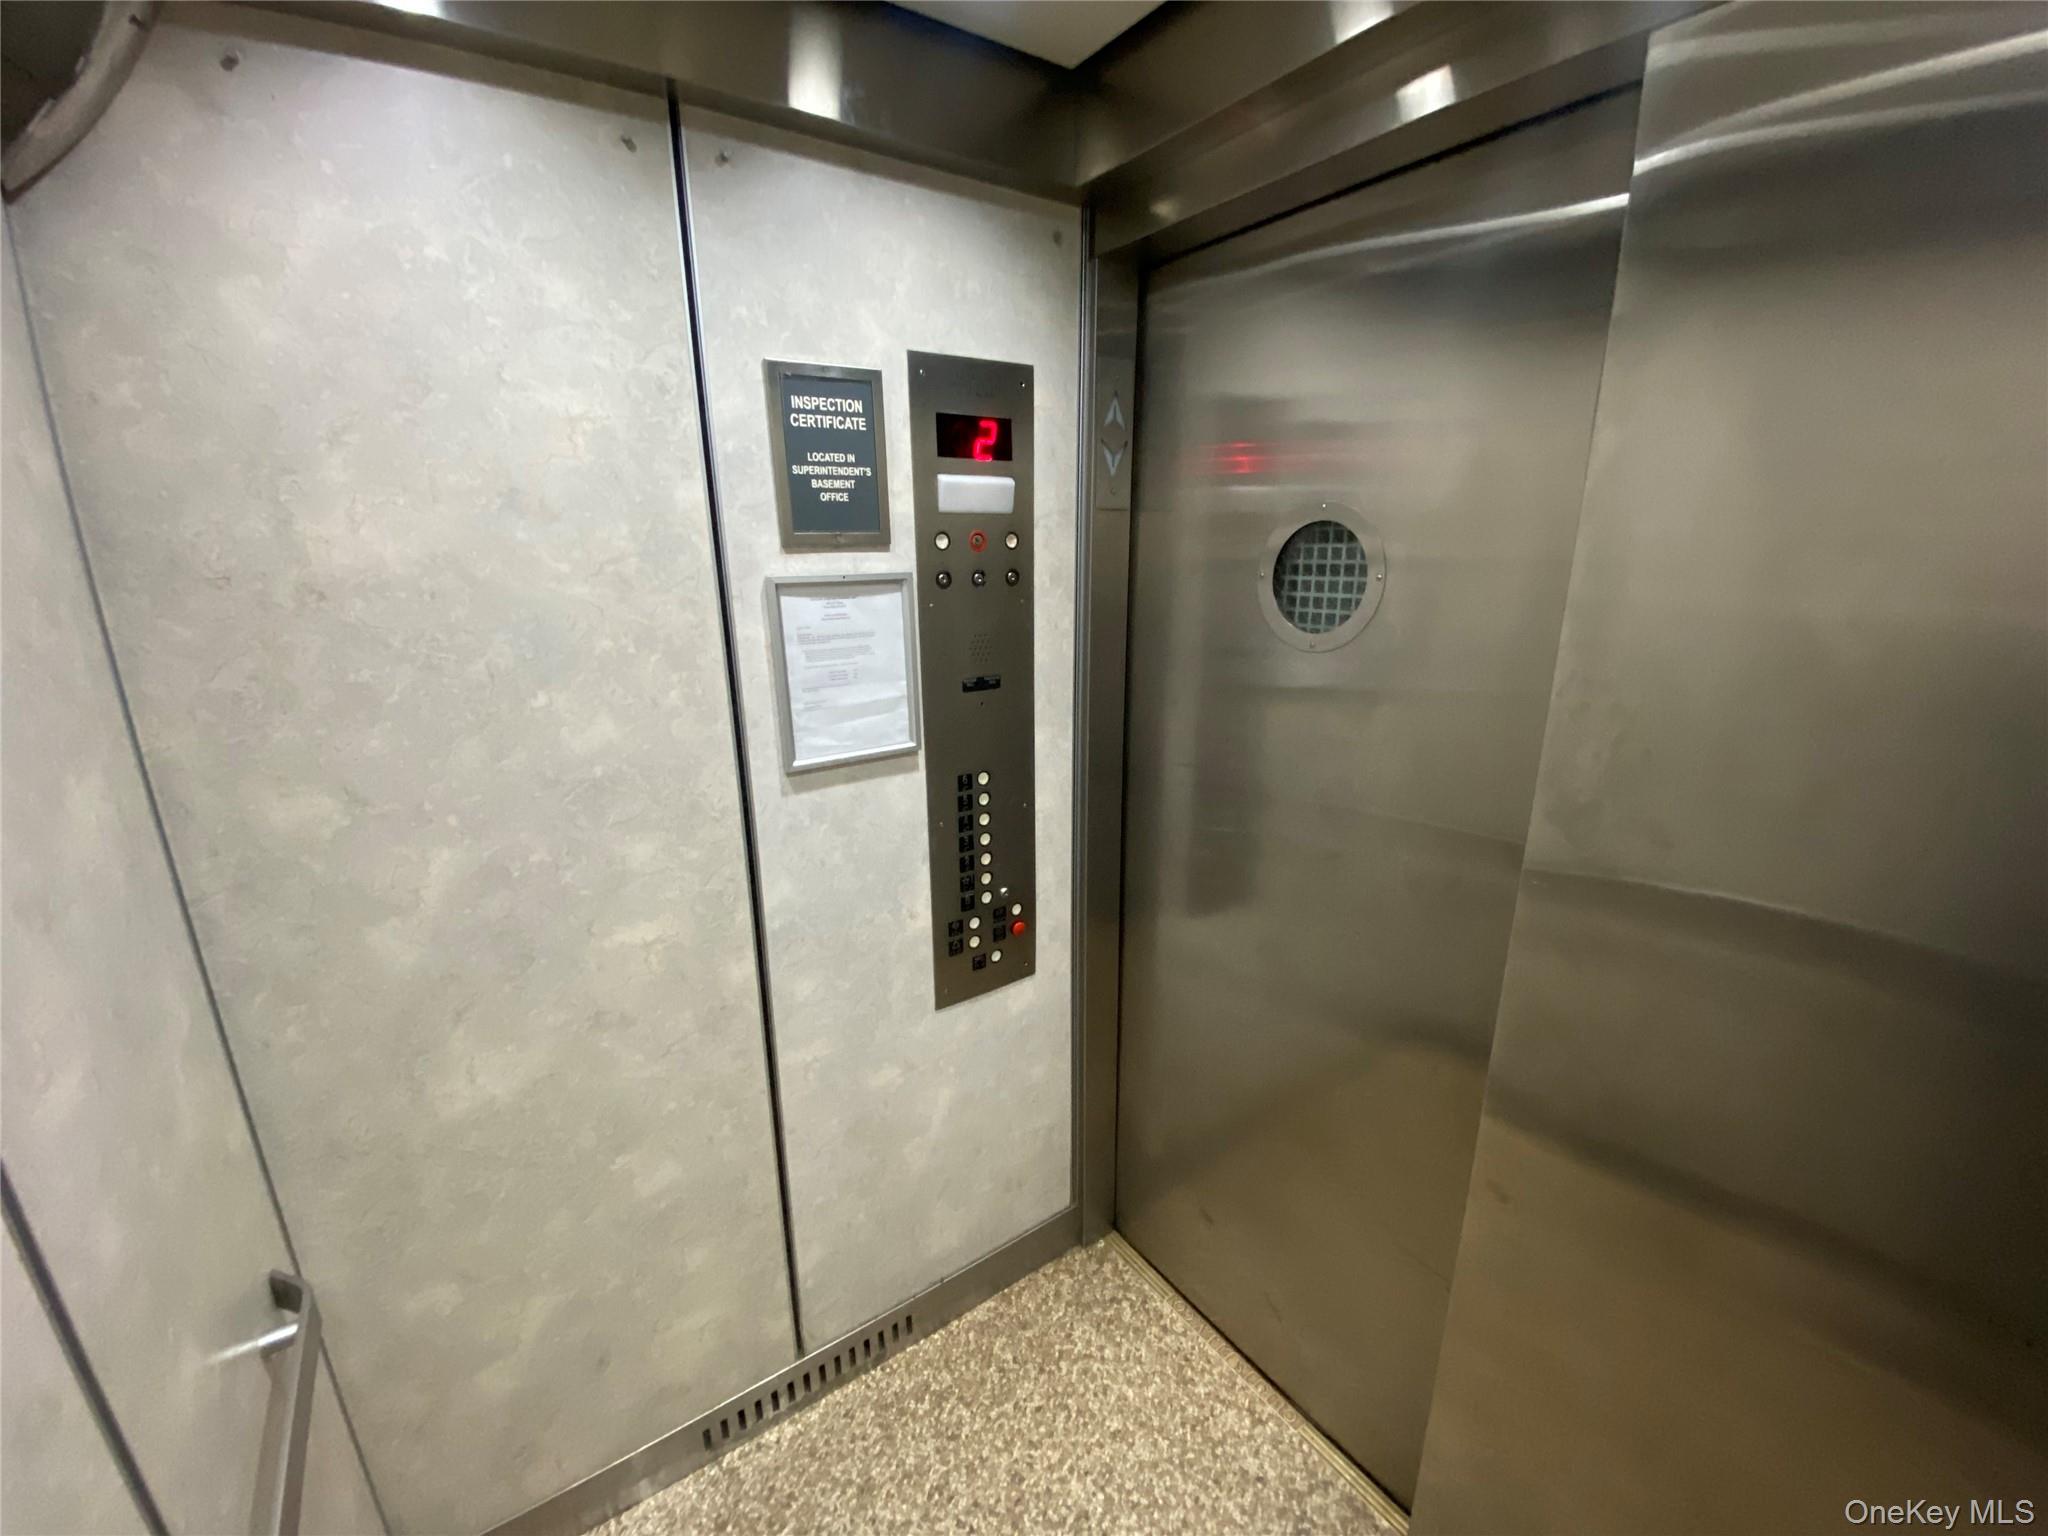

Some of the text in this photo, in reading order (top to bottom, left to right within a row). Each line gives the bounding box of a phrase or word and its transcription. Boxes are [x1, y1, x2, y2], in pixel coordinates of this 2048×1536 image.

[790, 395, 863, 413] INSPECTION
[790, 413, 867, 431] CERTIFICATE
[973, 419, 998, 461] 2
[807, 452, 856, 463] LOCATED IN
[791, 464, 872, 477] SUPERINTENDENT'S
[811, 478, 856, 489] BASEMENT
[820, 491, 849, 502] OFFICE
